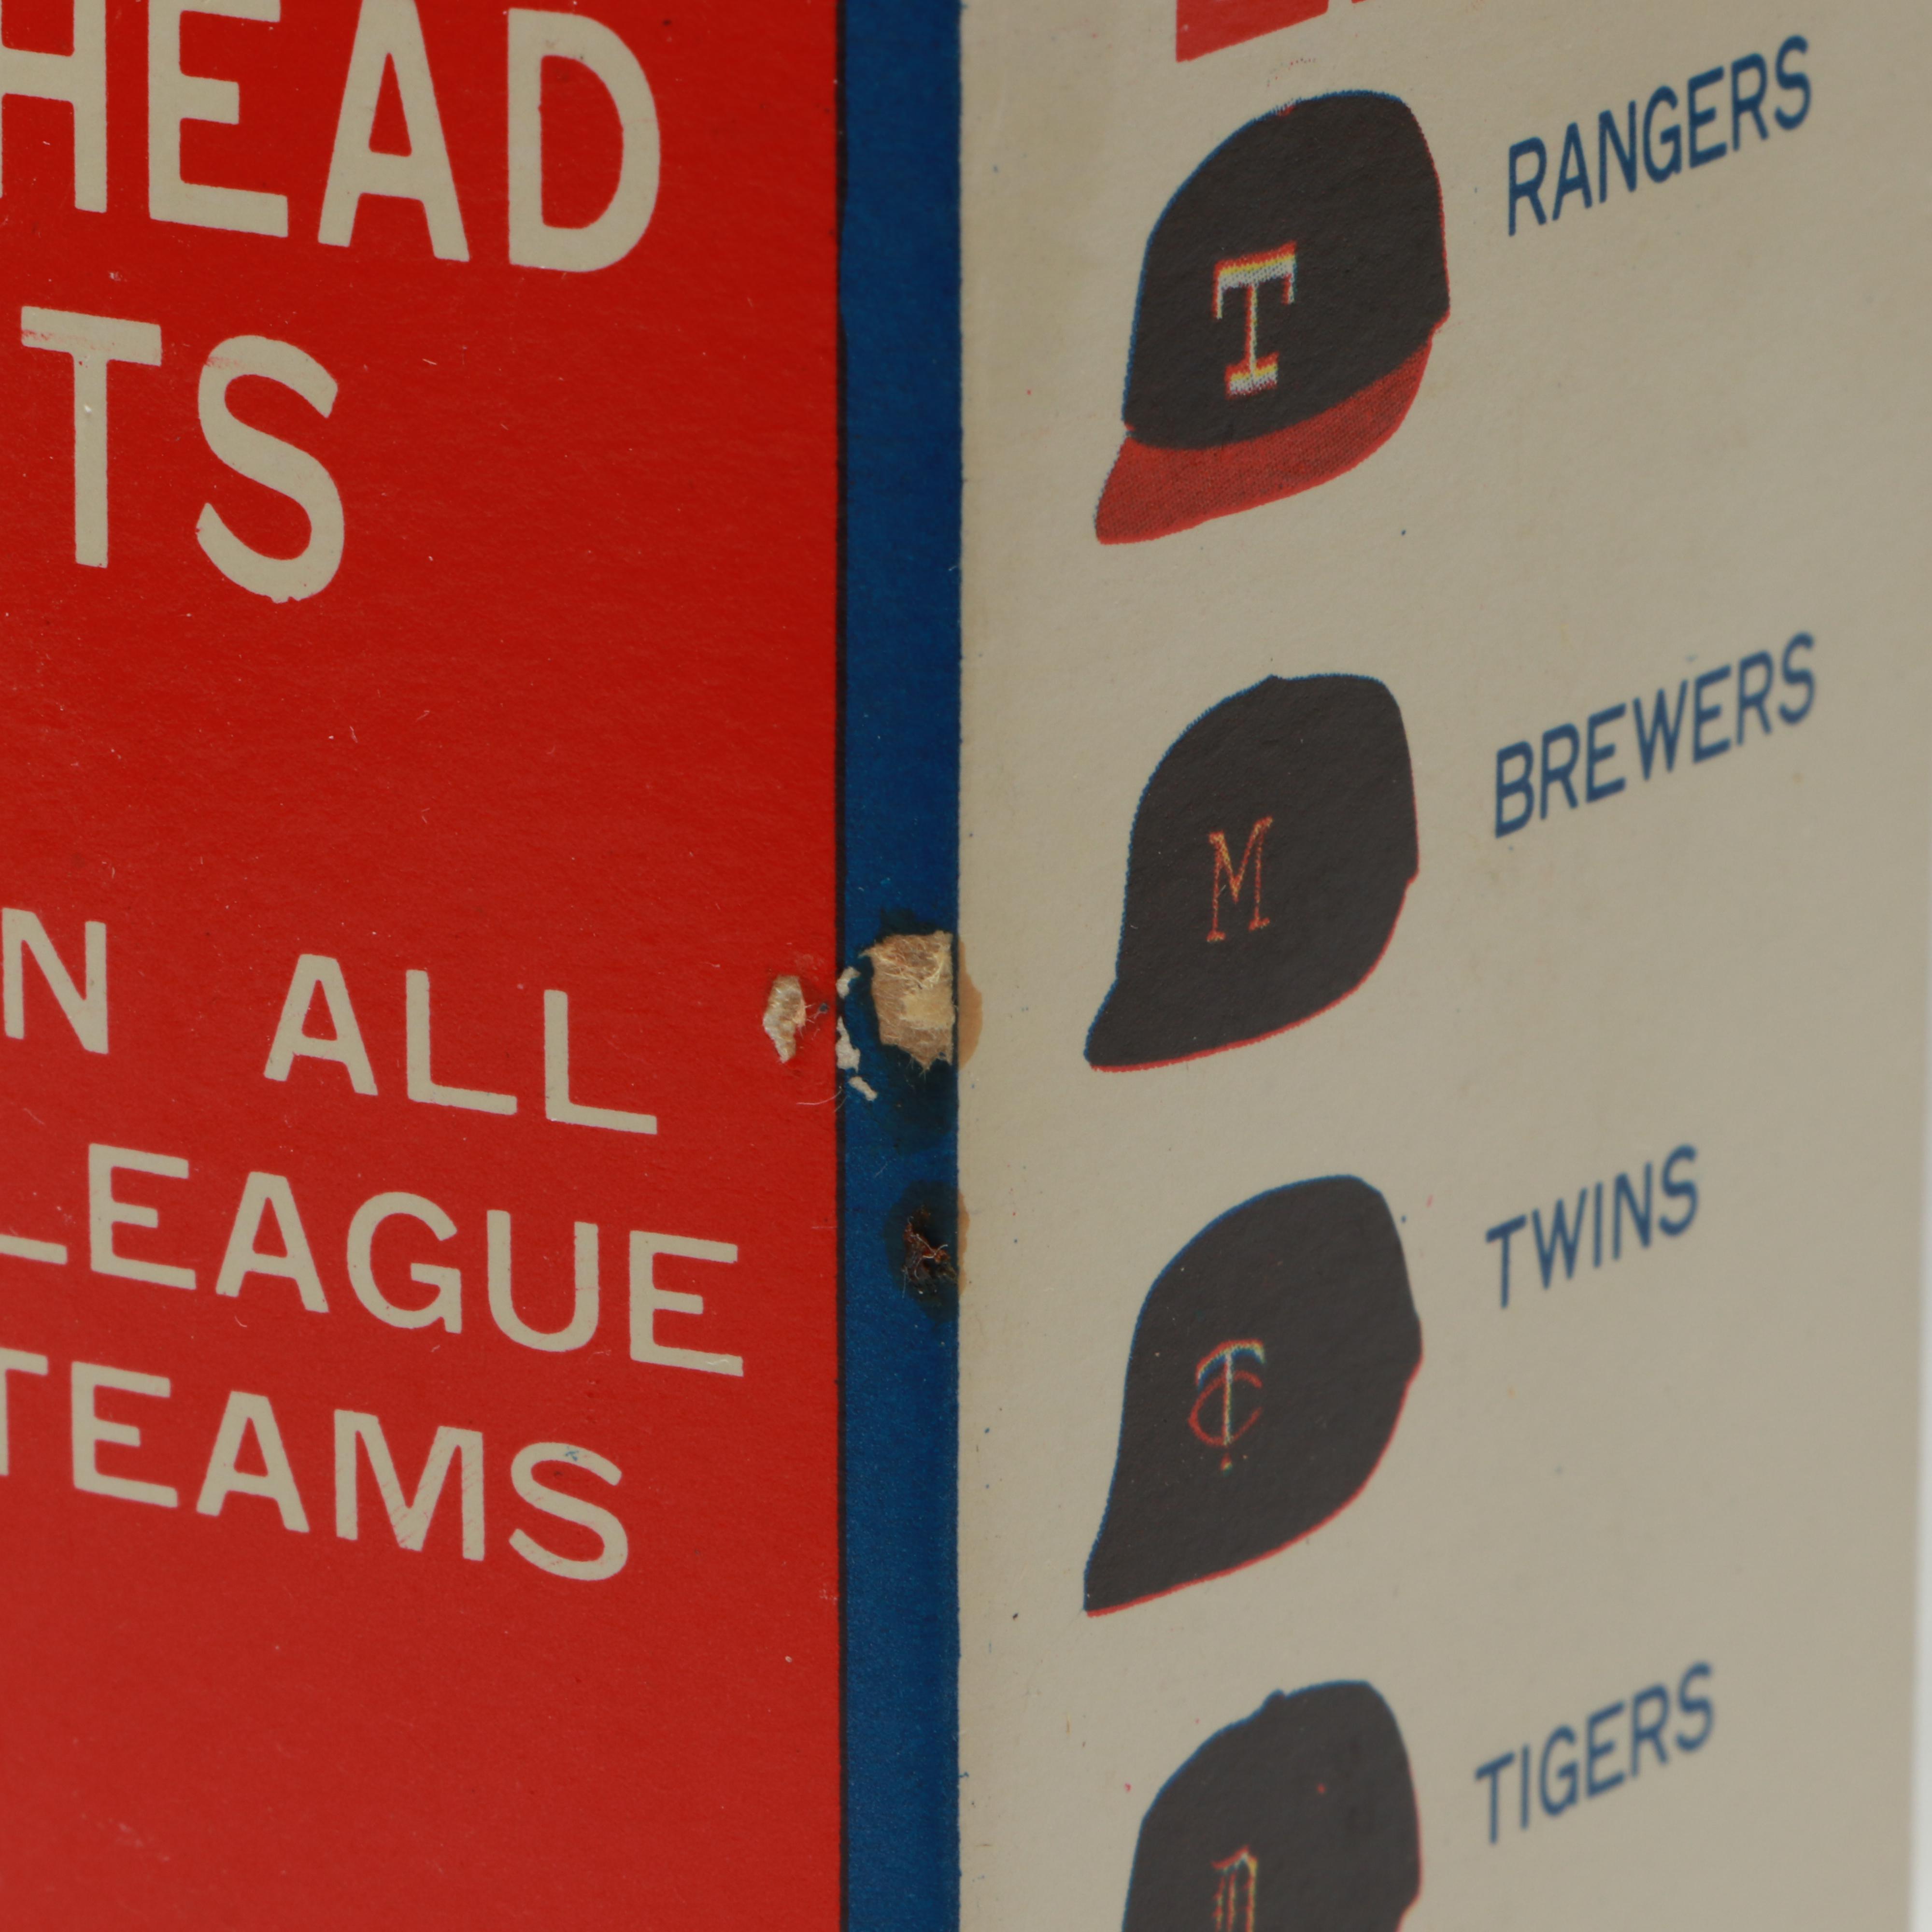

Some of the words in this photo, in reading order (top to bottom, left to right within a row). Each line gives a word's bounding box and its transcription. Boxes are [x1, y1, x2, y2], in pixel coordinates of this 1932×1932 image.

[0, 0, 660, 272] HEAD
[1508, 34, 1812, 237] RANGERS
[1211, 240, 1296, 400] T
[21, 306, 344, 603] TS
[1494, 631, 1816, 839] BREWERS
[1207, 815, 1273, 942] M
[264, 954, 657, 1135] ALL
[0, 1143, 743, 1377] EAGUE
[1485, 1143, 1699, 1309] TWINS
[1475, 1661, 1714, 1845] TIGERS
